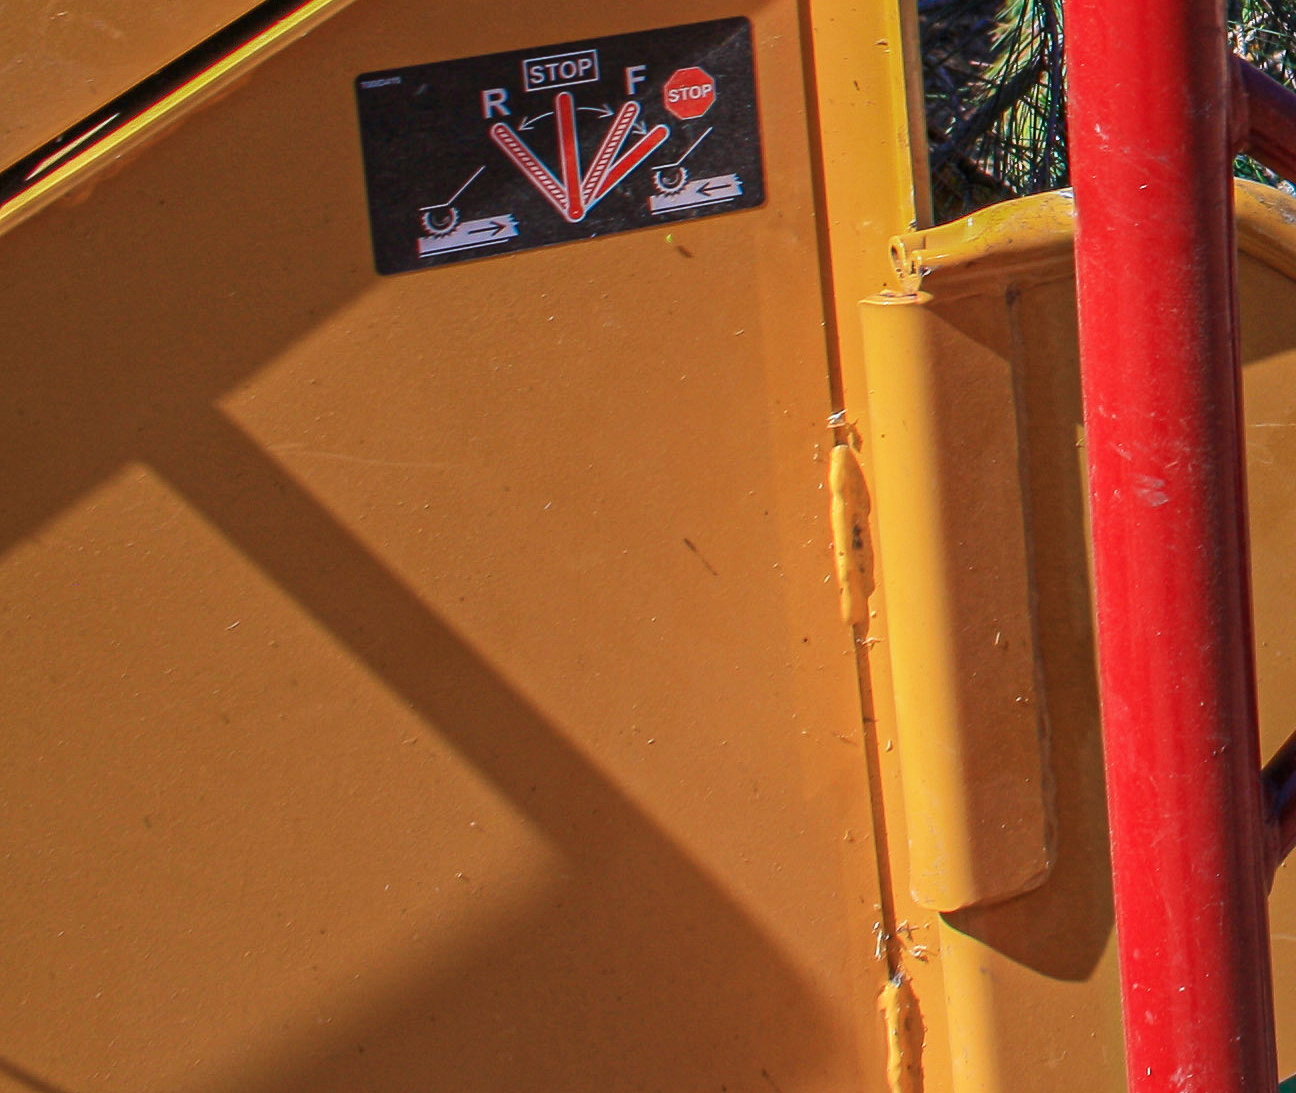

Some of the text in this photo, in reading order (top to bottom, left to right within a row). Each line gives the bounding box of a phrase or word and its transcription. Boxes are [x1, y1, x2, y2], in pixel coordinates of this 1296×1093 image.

[529, 59, 593, 84] STOP
[625, 65, 647, 95] F
[482, 88, 511, 118] R
[667, 83, 713, 103] STOP
